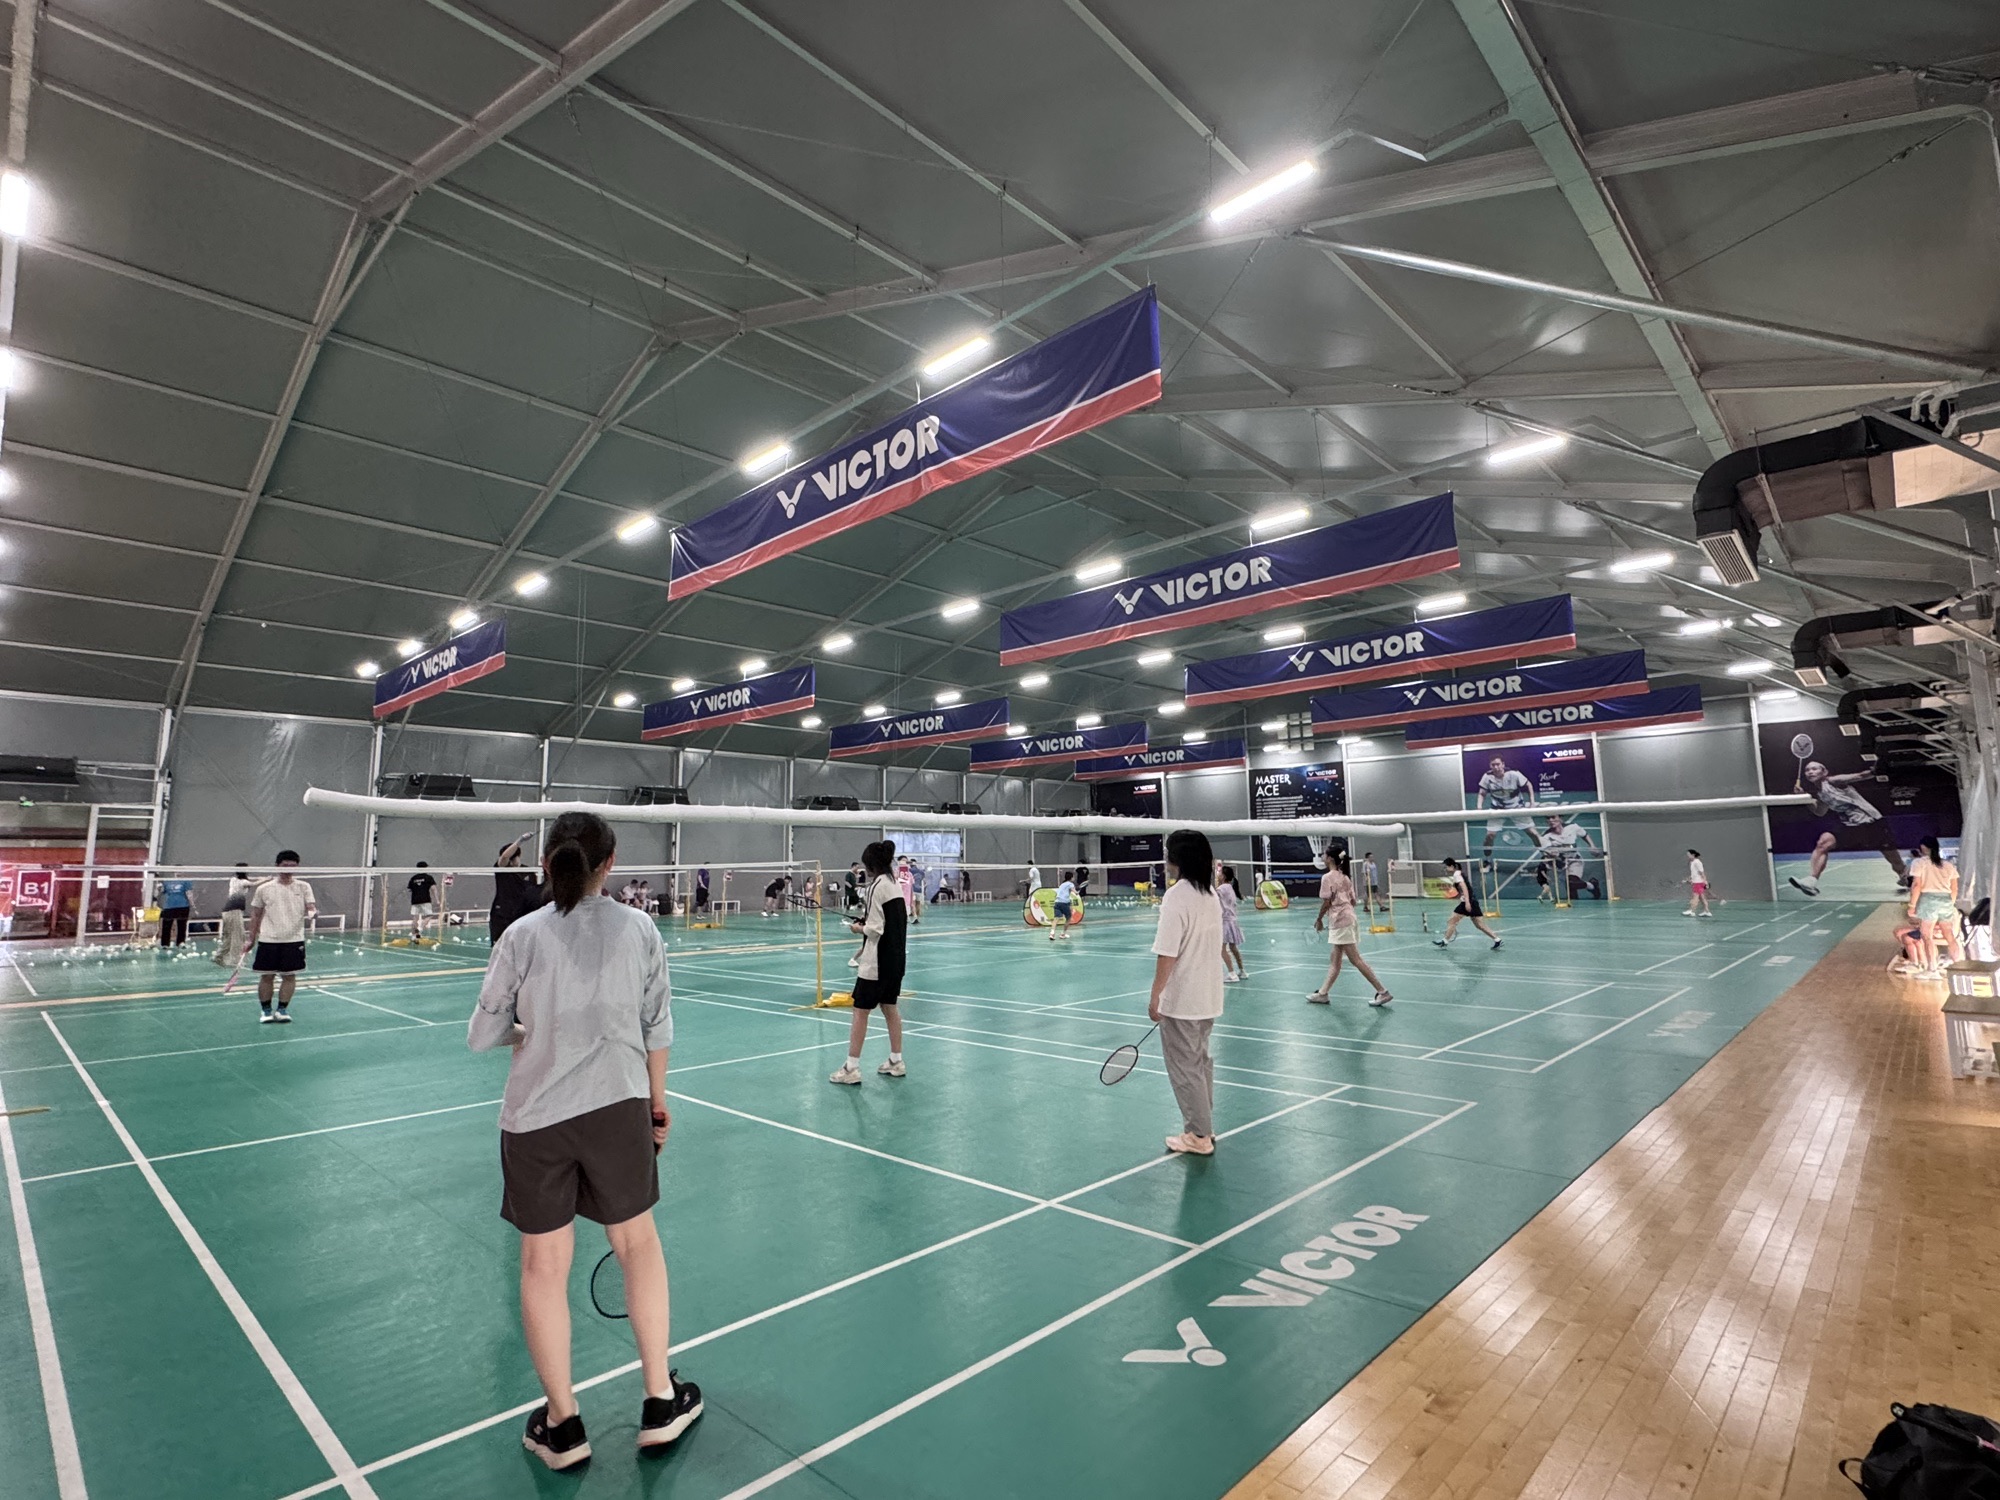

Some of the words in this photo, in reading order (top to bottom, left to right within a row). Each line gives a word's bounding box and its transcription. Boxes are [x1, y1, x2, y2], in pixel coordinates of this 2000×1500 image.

[812, 415, 940, 500] VICTOR
[1150, 557, 1272, 605] VICTOR
[1319, 632, 1424, 666] VICTOR
[421, 646, 458, 679] VICTOR
[1432, 676, 1522, 701] VICTOR
[704, 688, 750, 711] VICTOR
[896, 716, 944, 734] VICTOR
[1514, 705, 1593, 725] VICTOR
[1037, 736, 1084, 751] VICTOR
[1553, 748, 1584, 757] VICTOR
[1138, 750, 1185, 764] VICTOR
[1255, 773, 1291, 785] MASTER
[1255, 784, 1280, 797] ACE
[24, 882, 49, 895] B1
[1207, 1205, 1430, 1307] VICTOR
